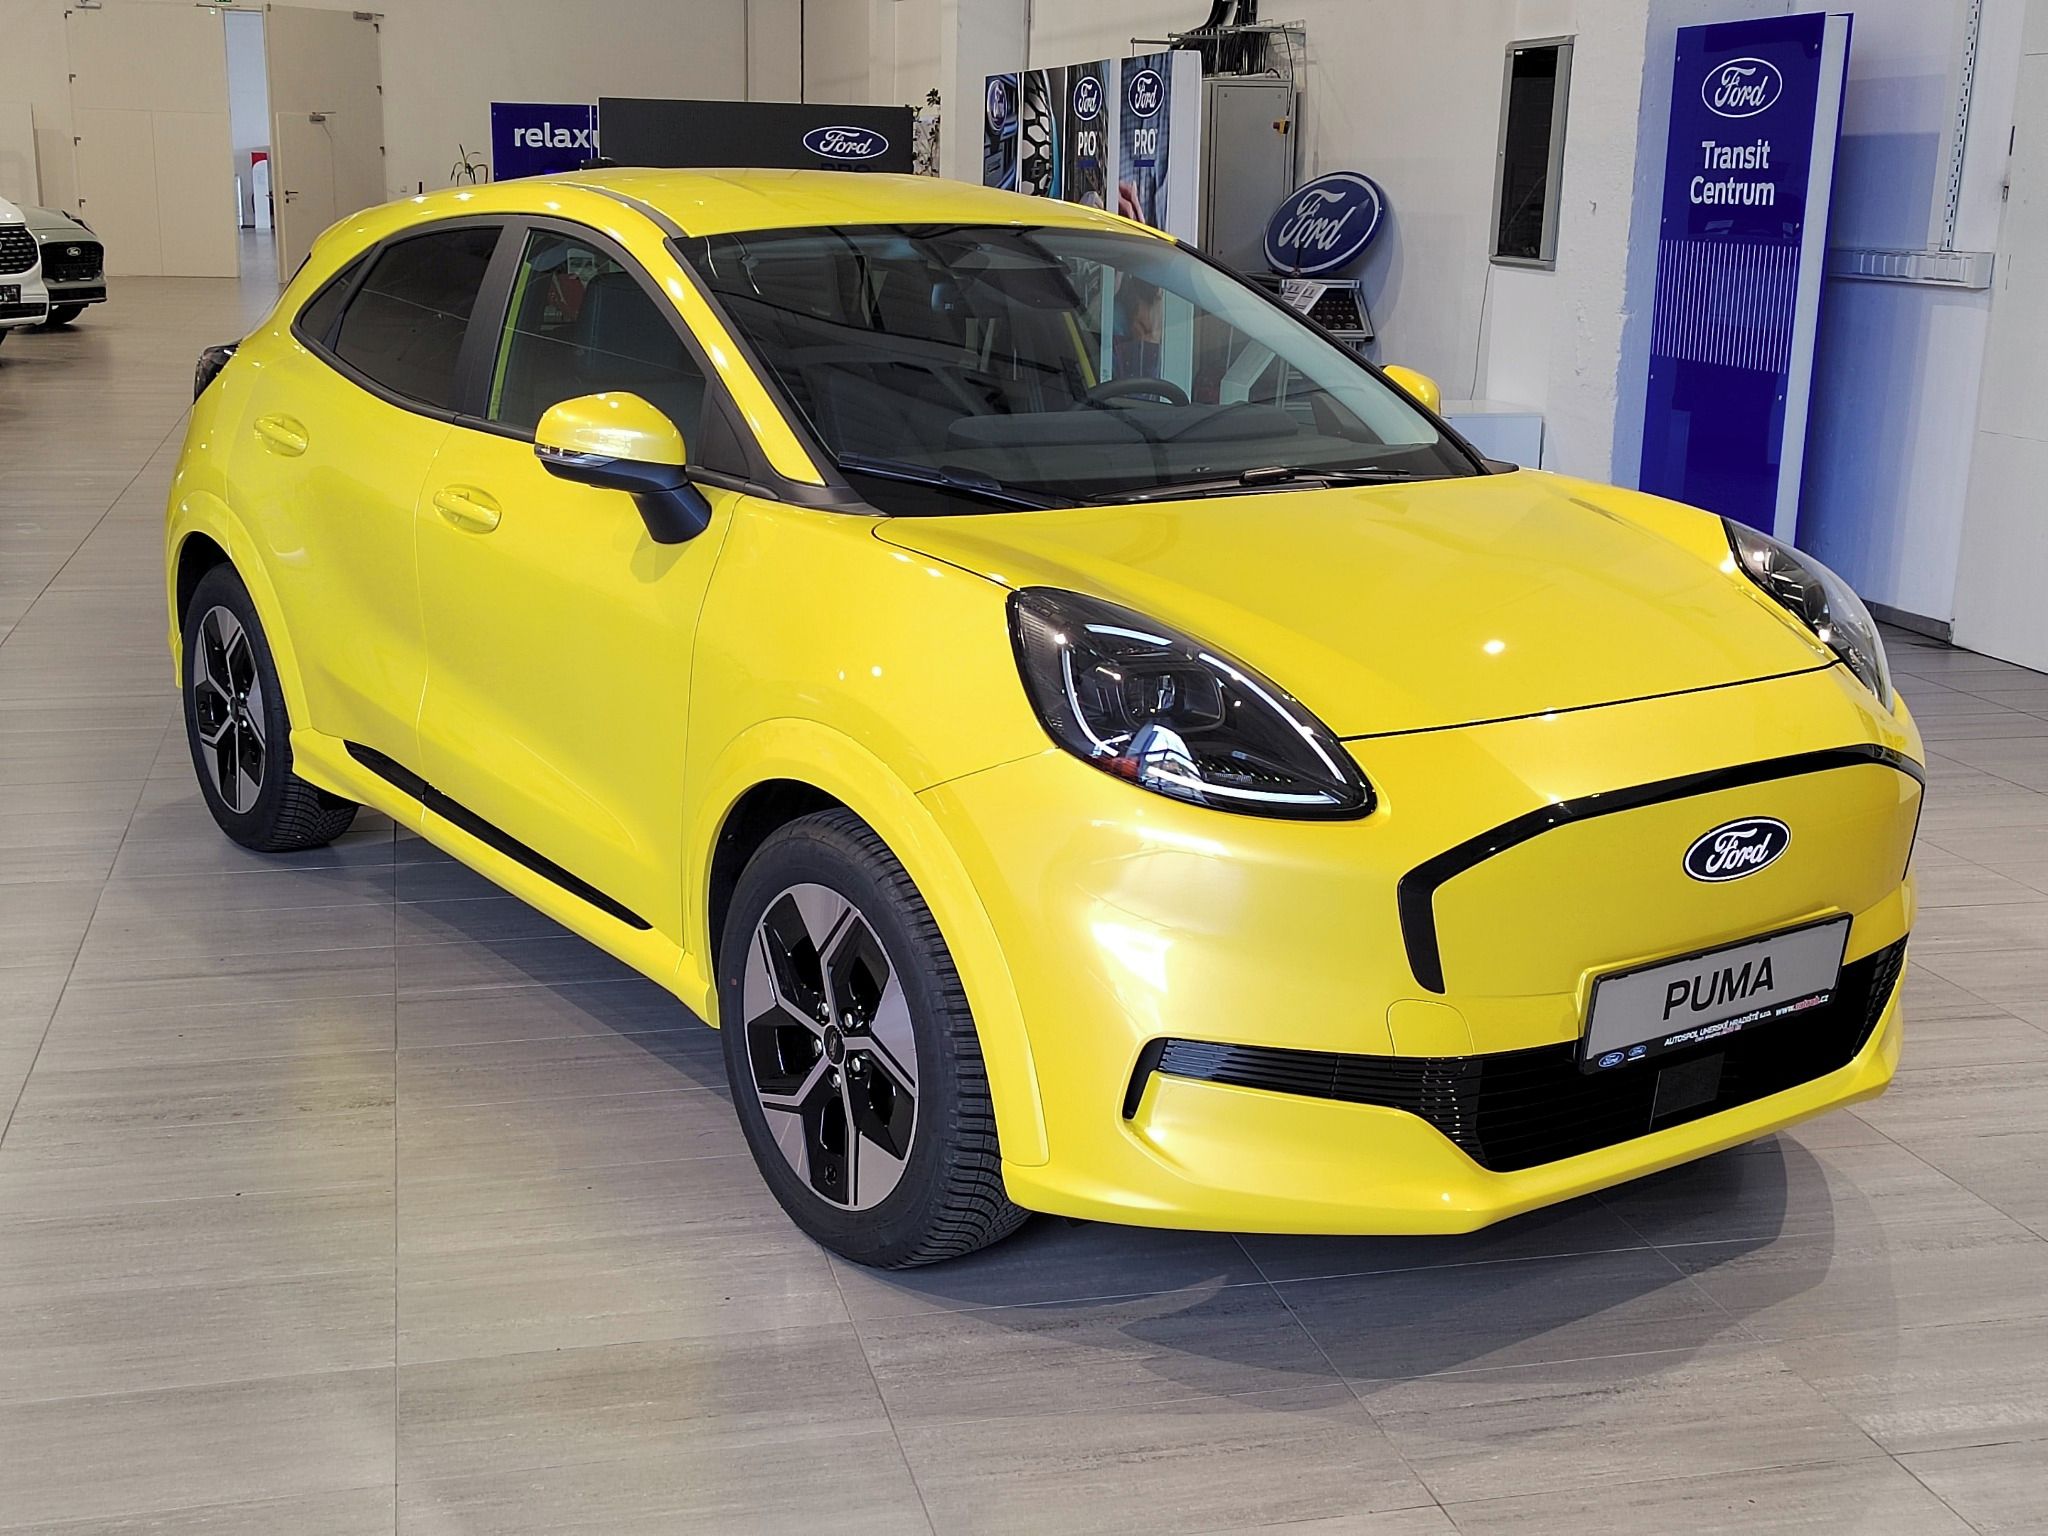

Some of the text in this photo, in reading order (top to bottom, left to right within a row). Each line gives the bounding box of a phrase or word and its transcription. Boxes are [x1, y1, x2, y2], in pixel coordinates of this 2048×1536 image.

[1078, 83, 1098, 113] Ford
[1135, 77, 1159, 110] Ford
[1714, 66, 1769, 108] Ford
[820, 130, 873, 154] Ford
[1134, 128, 1156, 155] PRO
[1702, 139, 1771, 169] Transit
[1690, 175, 1775, 206] Centrum
[1278, 188, 1357, 251] Ford
[1705, 827, 1773, 874] Ford
[1663, 956, 1774, 1020] PUMA
